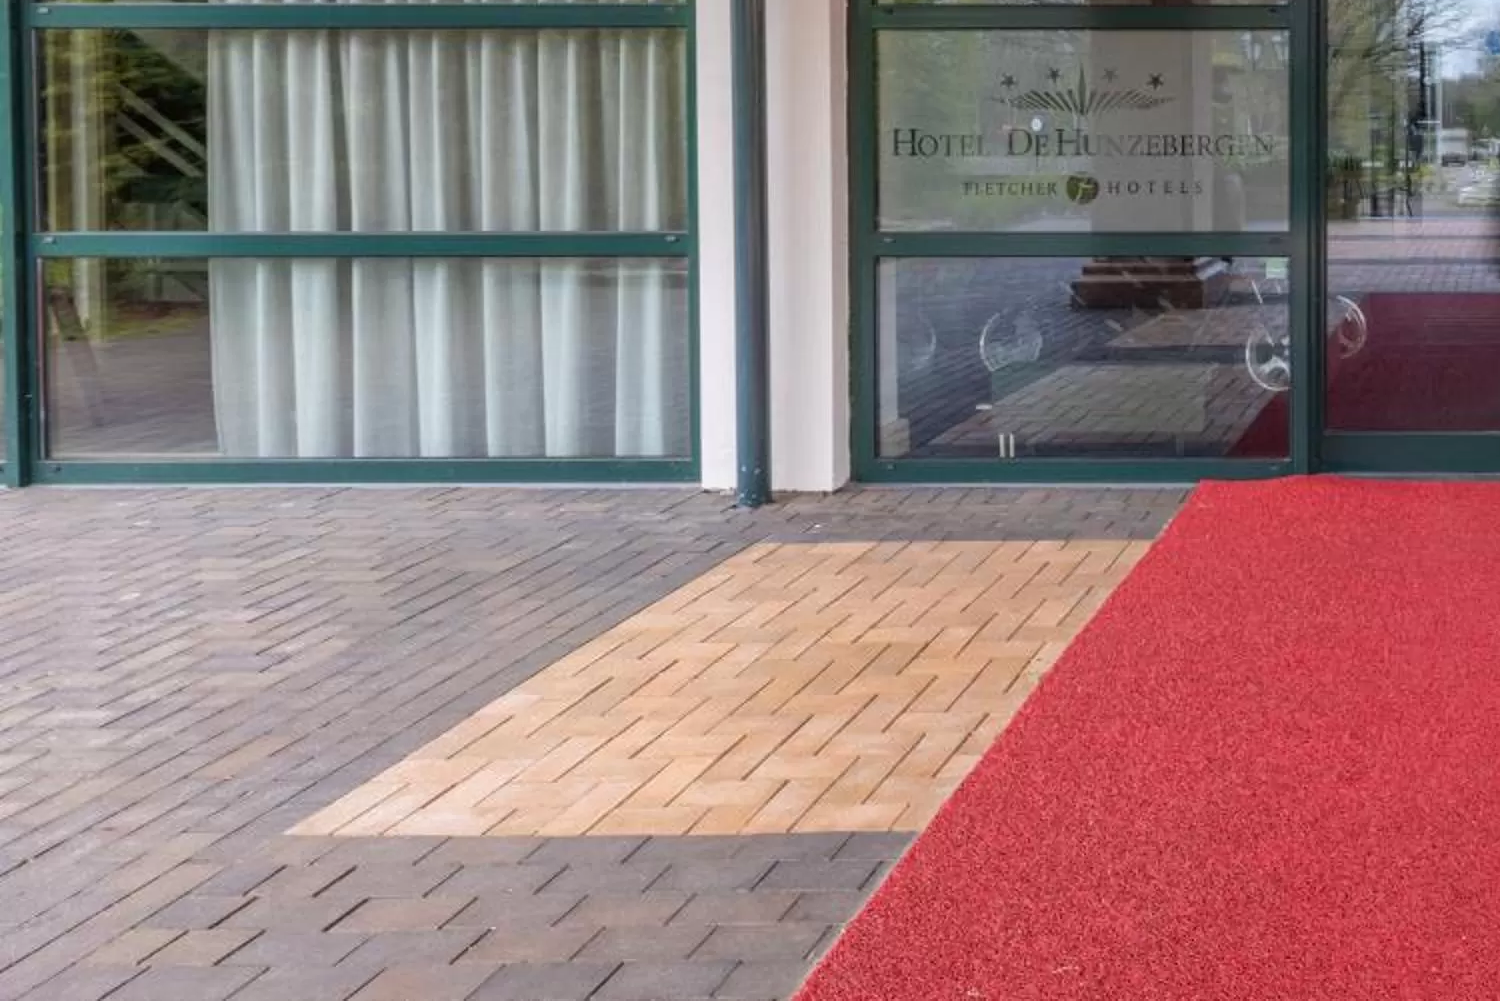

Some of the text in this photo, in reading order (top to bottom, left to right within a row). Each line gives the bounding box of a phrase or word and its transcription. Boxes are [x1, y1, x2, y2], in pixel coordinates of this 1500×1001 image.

[892, 127, 990, 158] HOTEL
[961, 179, 1204, 197] FLETCHER HOTELS
